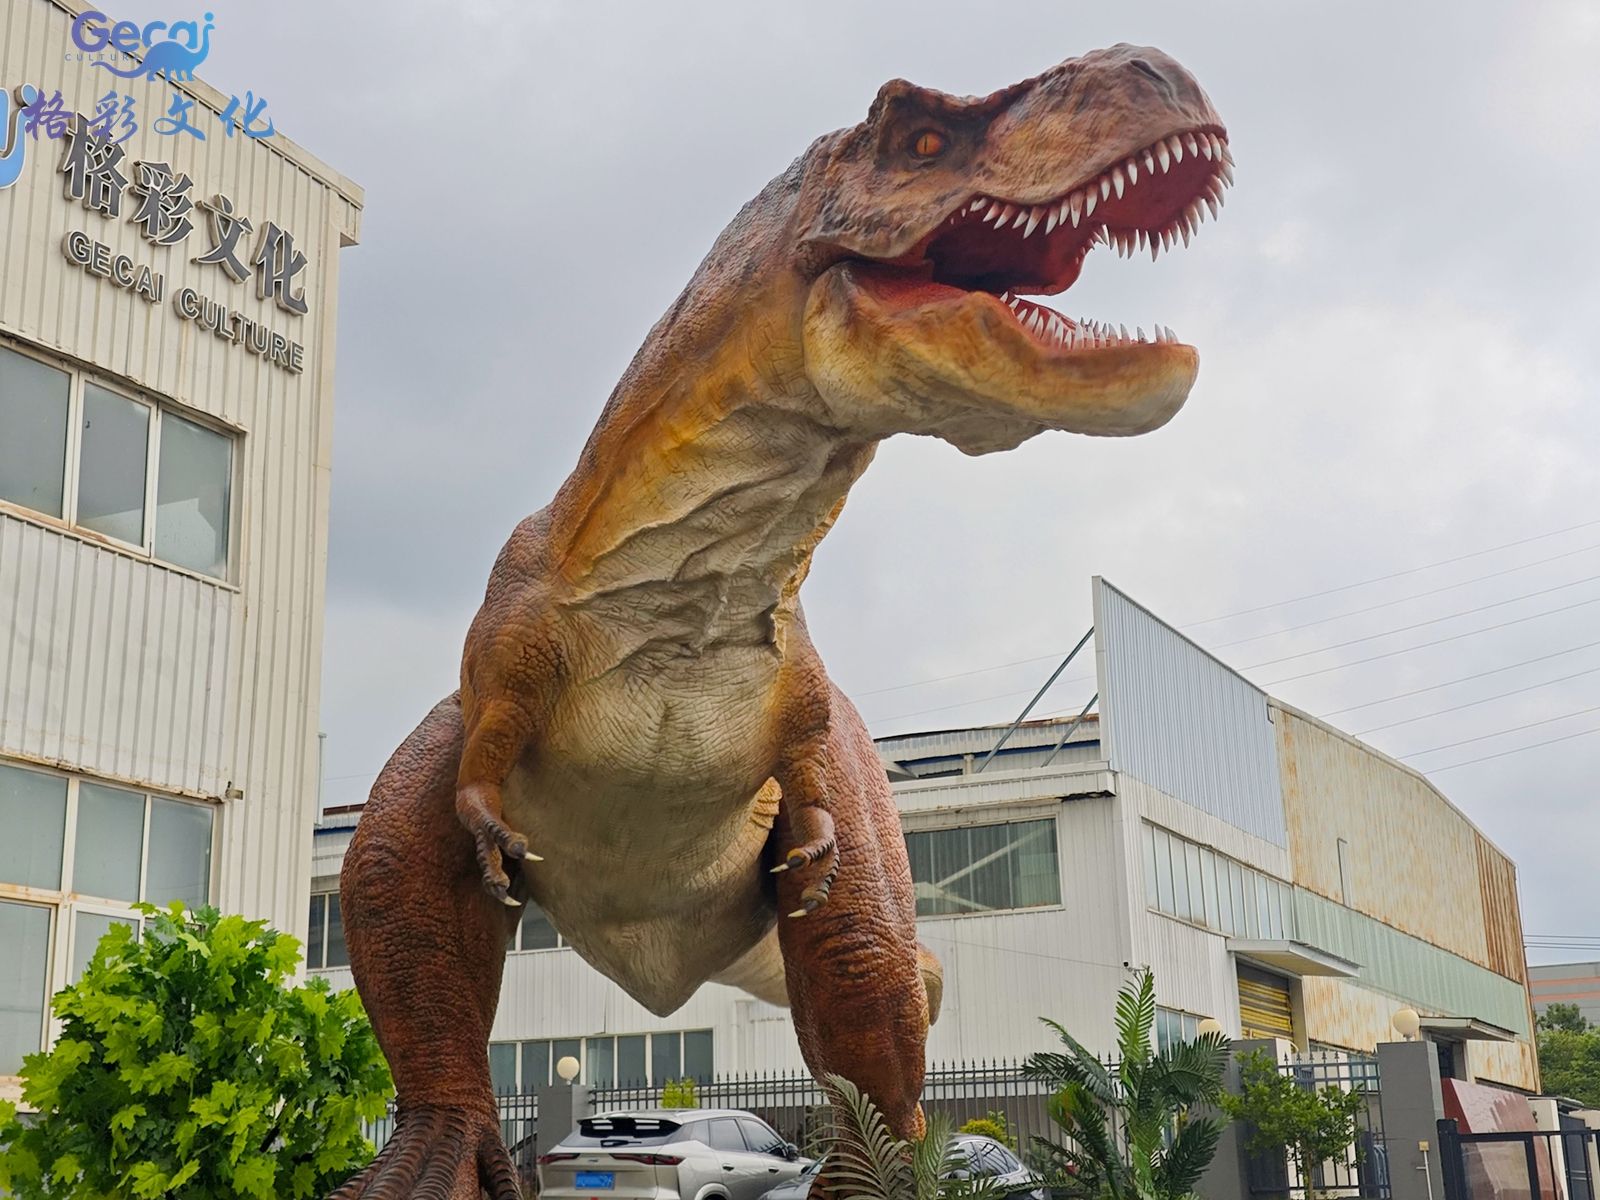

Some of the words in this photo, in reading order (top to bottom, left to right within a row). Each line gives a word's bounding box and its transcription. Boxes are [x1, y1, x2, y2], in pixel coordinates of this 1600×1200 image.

[59, 112, 309, 316] 格彩文化
[64, 230, 164, 305] GECAI
[174, 288, 304, 374] CULTURE
